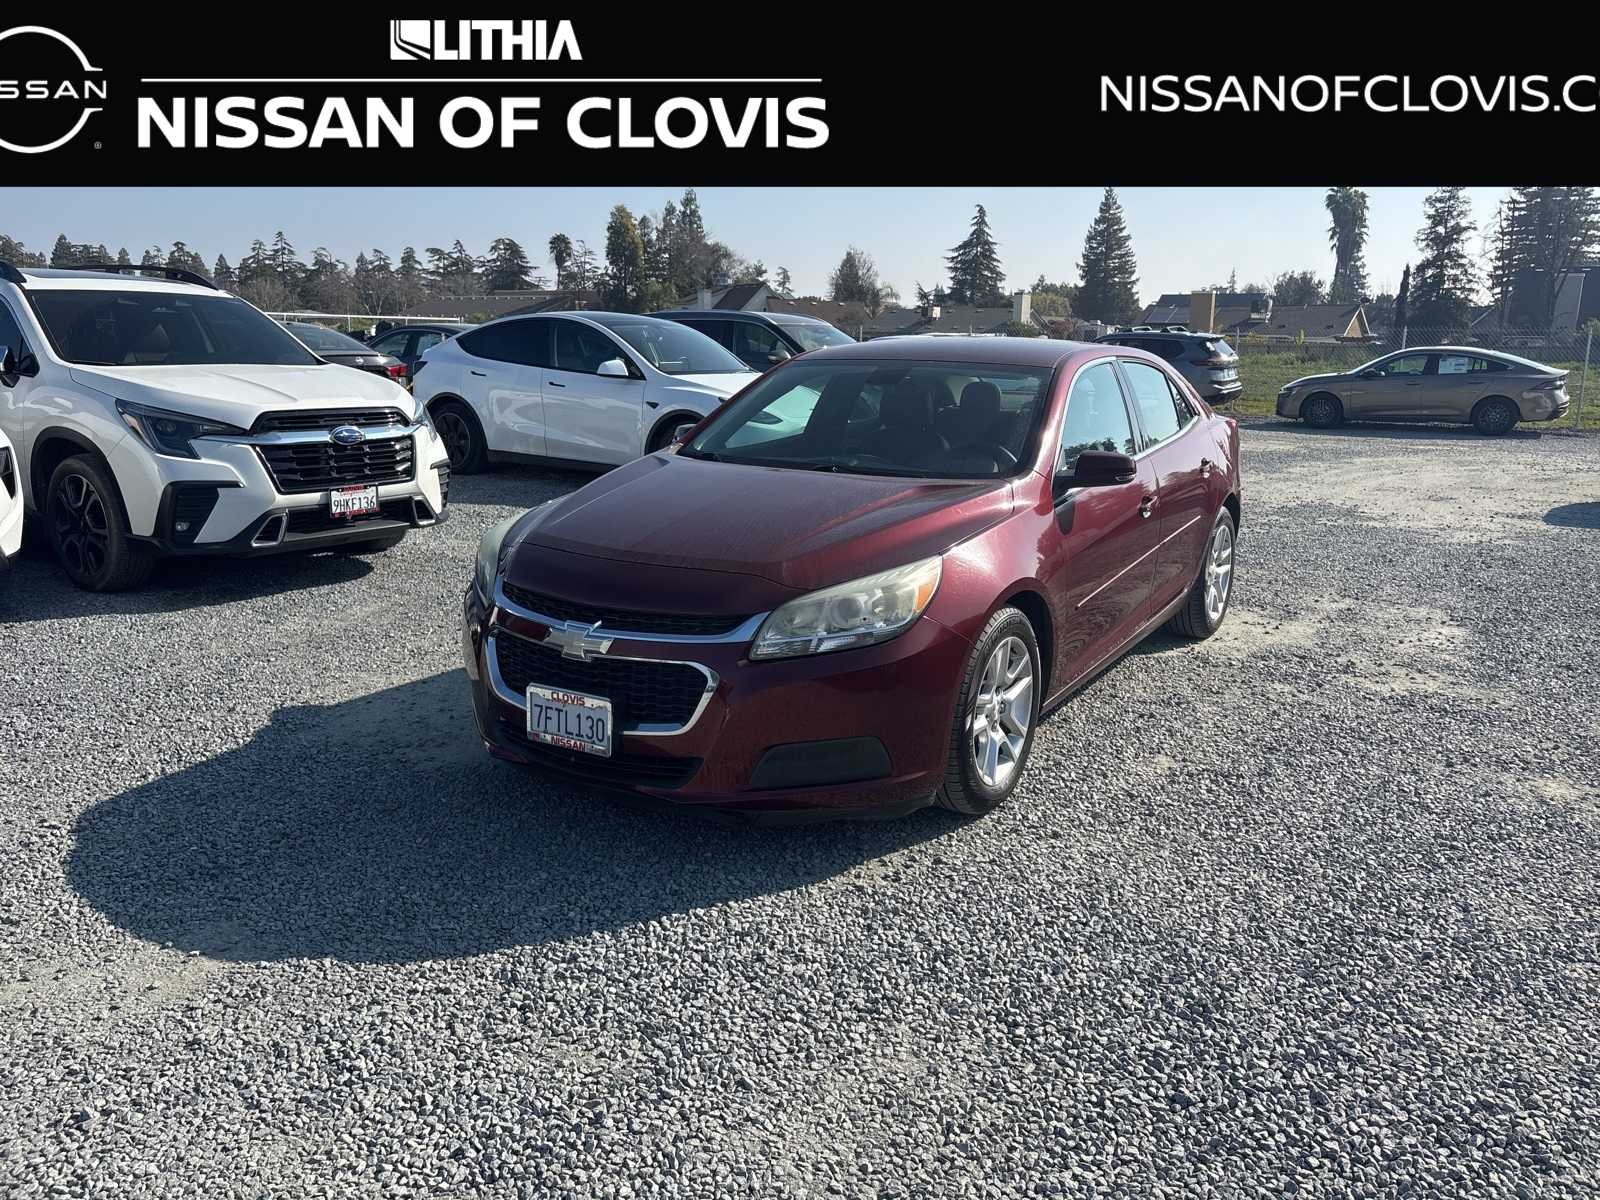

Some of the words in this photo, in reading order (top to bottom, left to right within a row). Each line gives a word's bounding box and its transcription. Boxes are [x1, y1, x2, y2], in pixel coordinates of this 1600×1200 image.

[332, 495, 376, 513] 9HKF136
[550, 691, 586, 706] CLOVIS
[533, 703, 606, 743] 7FTL130
[550, 736, 586, 752] NISSAN
